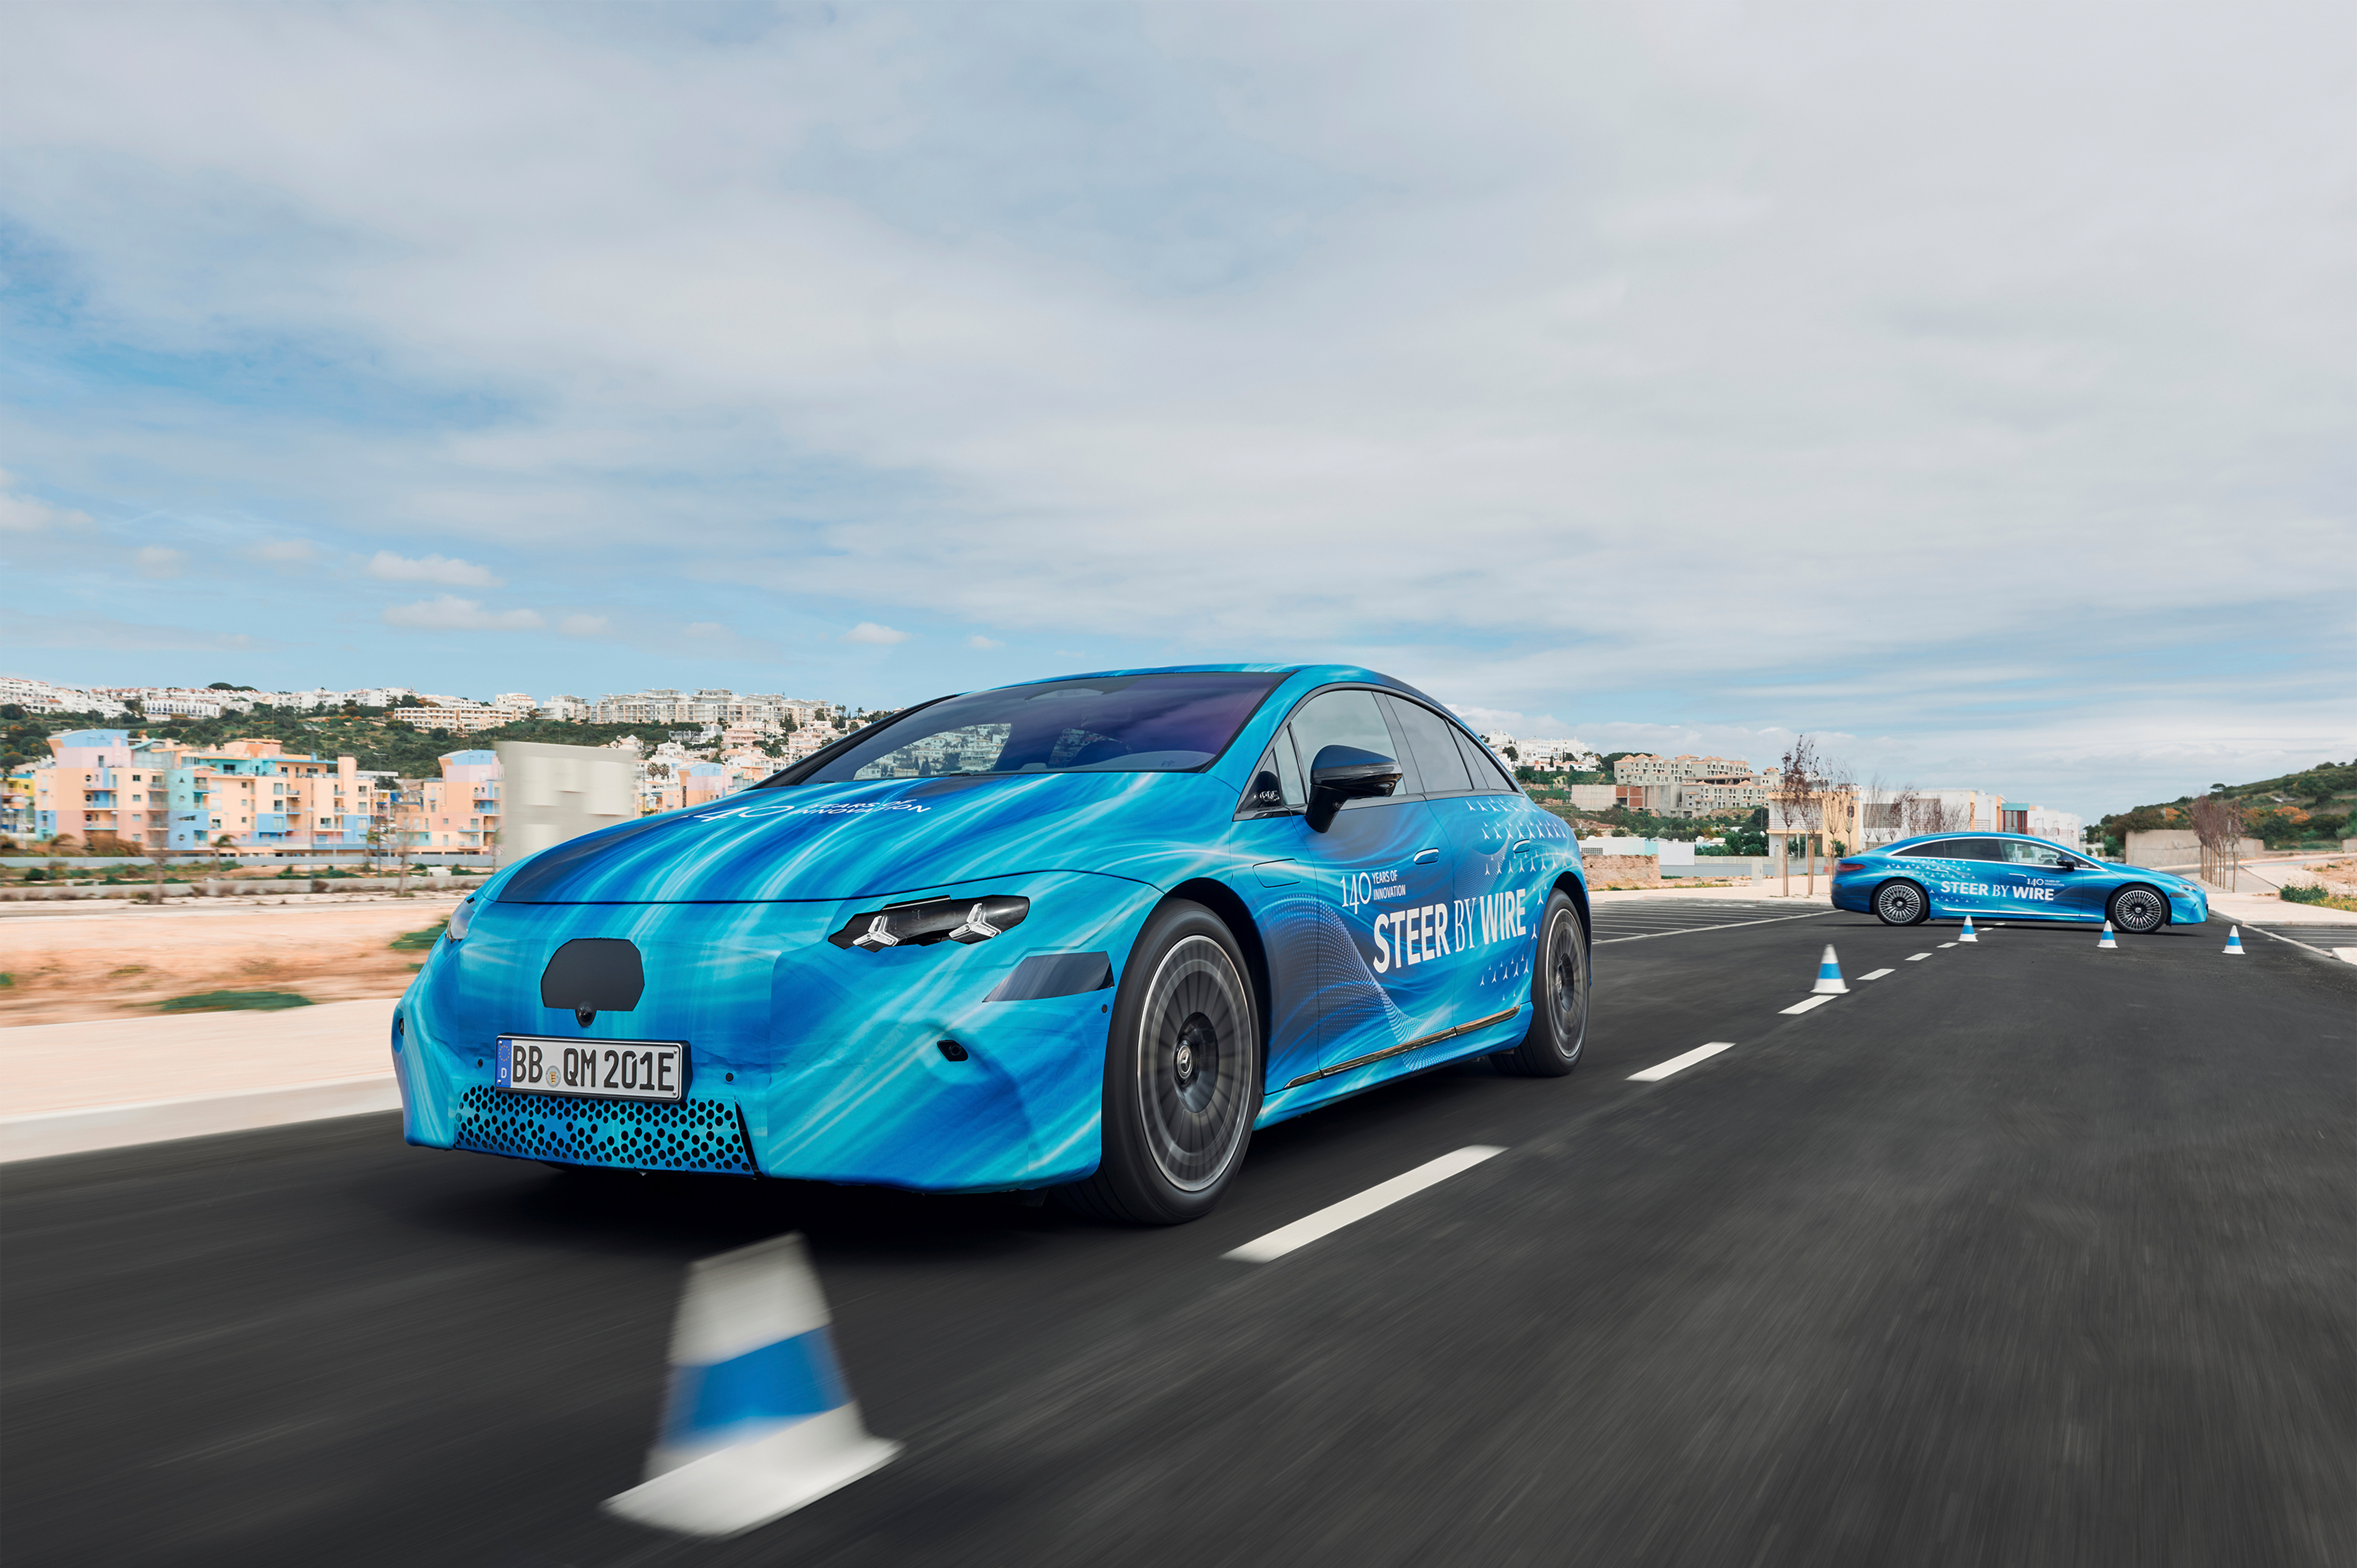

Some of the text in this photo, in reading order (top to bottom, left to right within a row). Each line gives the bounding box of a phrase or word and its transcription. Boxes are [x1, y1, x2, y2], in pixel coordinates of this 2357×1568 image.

[682, 806, 795, 822] 40
[1371, 869, 1398, 884] YEARS OF
[2027, 878, 2044, 887] 140
[1340, 872, 1371, 915] 140
[1373, 884, 1406, 900] INNOVATION
[1940, 880, 2054, 901] STEER BY WIRE
[1373, 888, 1526, 974] STEER BY WIRE
[501, 1067, 507, 1078] D
[512, 1045, 543, 1083] BB
[563, 1048, 597, 1088] QM
[604, 1049, 675, 1091] 201E
